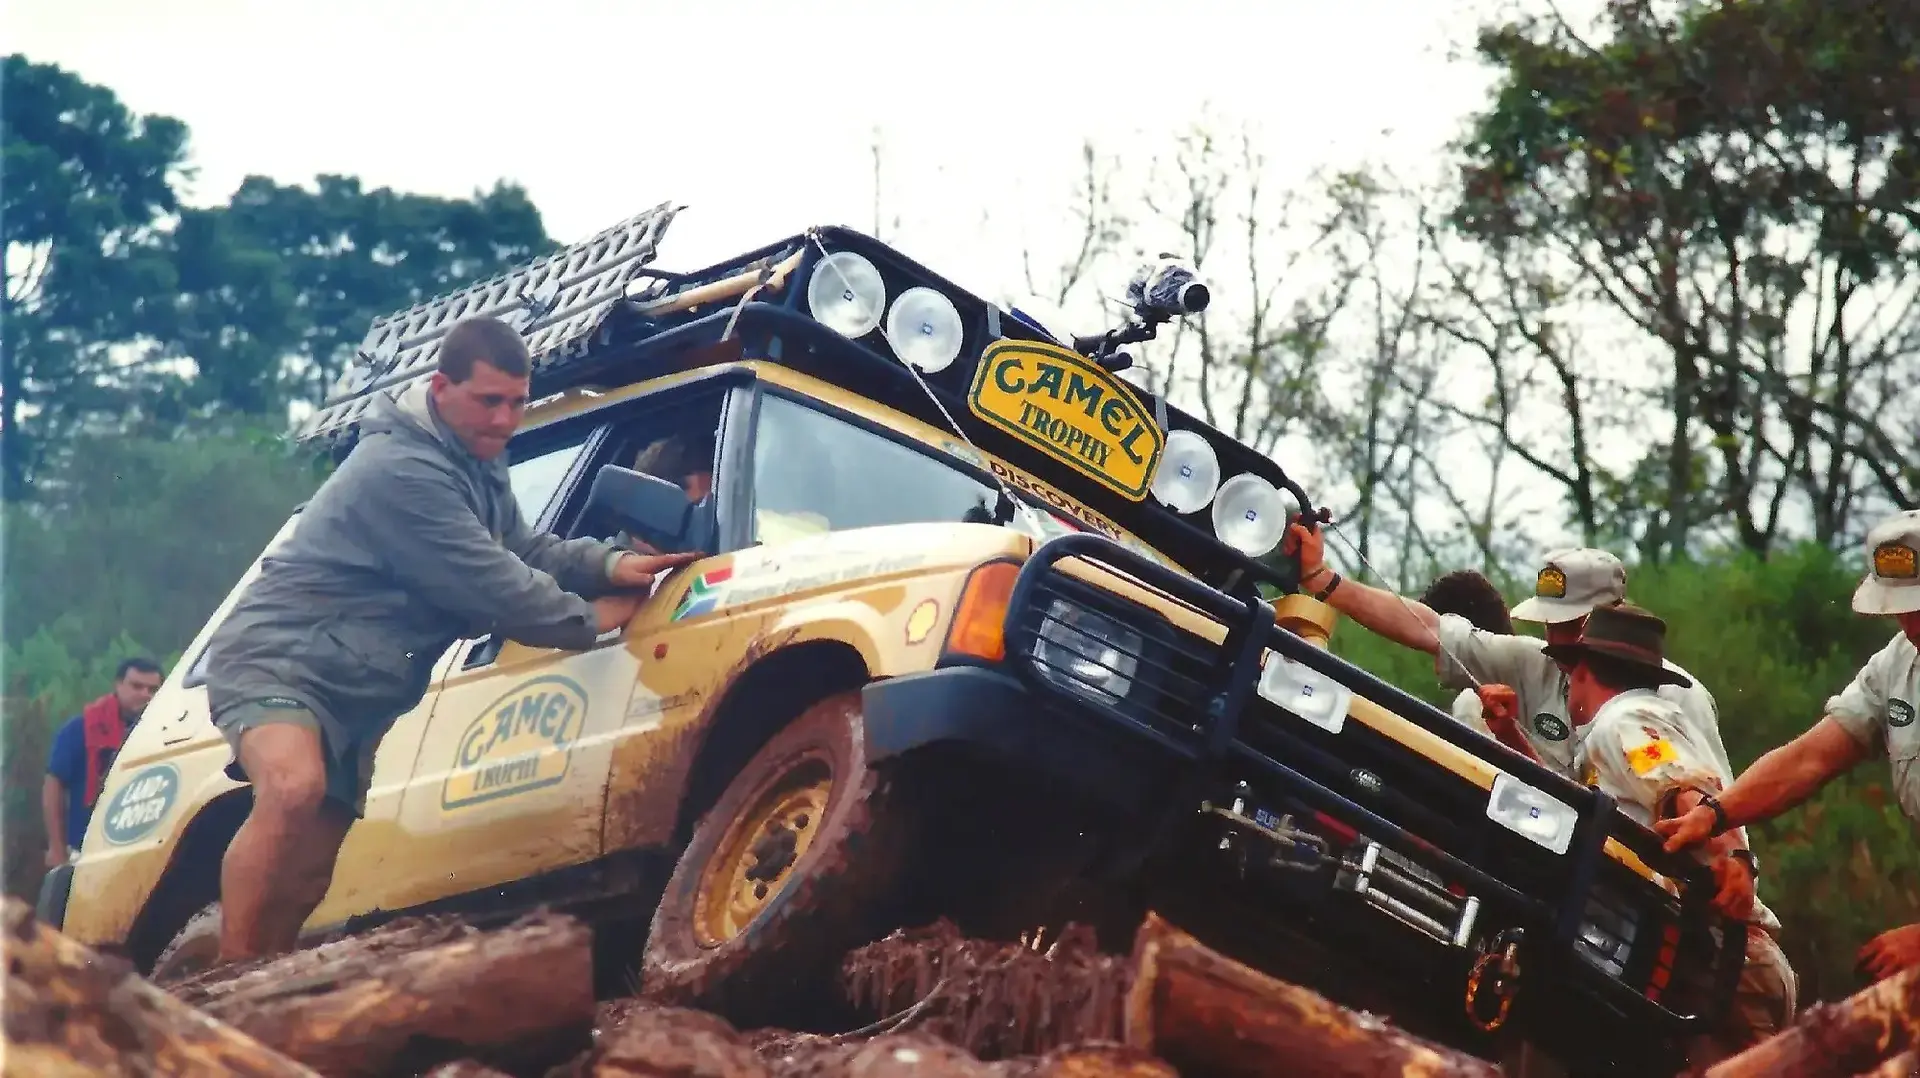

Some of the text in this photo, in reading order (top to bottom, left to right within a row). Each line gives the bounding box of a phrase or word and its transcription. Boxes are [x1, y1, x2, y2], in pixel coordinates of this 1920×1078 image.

[995, 359, 1145, 465] CAMEL
[1018, 400, 1114, 466] TROPHY
[989, 461, 1121, 540] DISCOVERY
[460, 691, 576, 768] CAMEL
